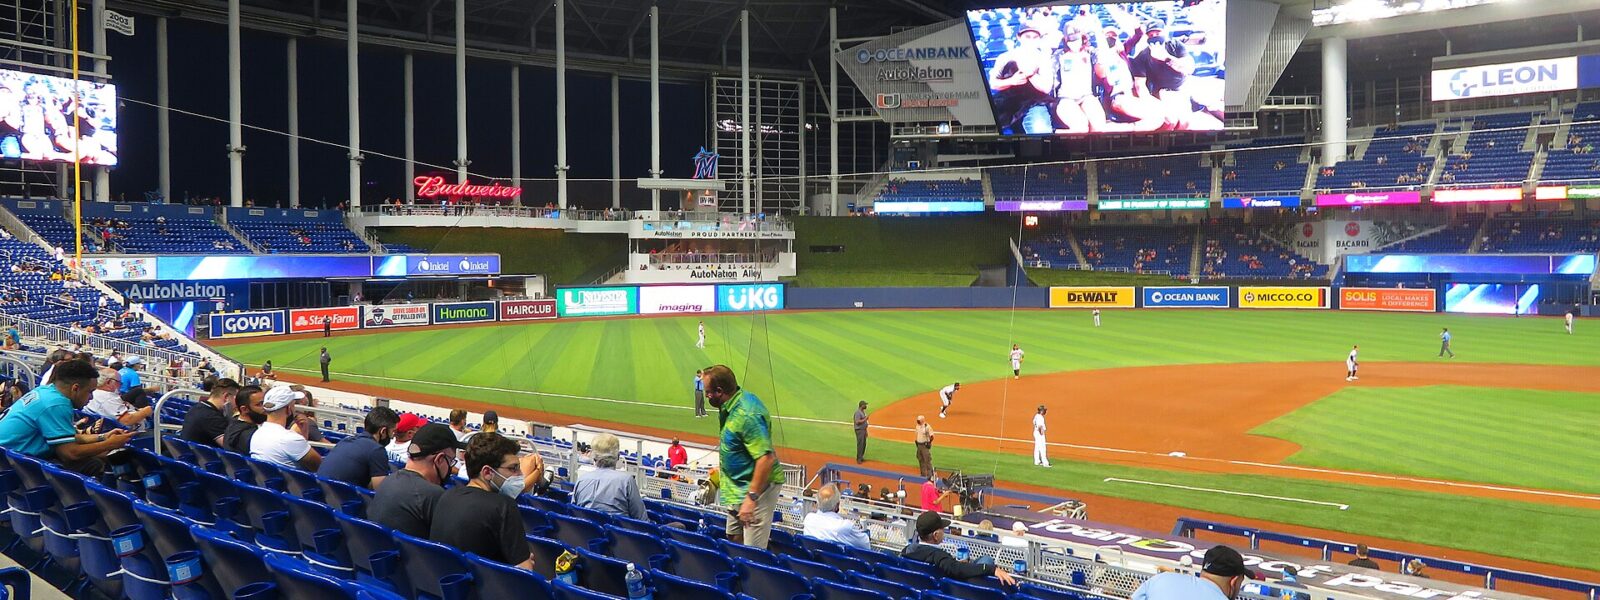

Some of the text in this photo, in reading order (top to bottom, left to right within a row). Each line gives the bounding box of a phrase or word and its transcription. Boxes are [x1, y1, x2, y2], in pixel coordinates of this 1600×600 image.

[110, 13, 128, 25] 2003
[877, 66, 953, 81] AutoNation
[1482, 64, 1557, 87] LEON
[414, 176, 523, 197] Budweiser
[430, 261, 449, 271] Inktel
[470, 261, 489, 270] Inktel
[690, 270, 761, 279] AutoNation Alley
[130, 283, 226, 299] AutoNation
[1345, 291, 1377, 302] SOLIS
[1164, 293, 1220, 301] OCEAN BANK
[1257, 293, 1313, 302] MICCO.CO
[507, 304, 552, 315] HAIRCLUB
[659, 303, 702, 312] imaging
[333, 313, 355, 322] Farm
[225, 315, 271, 332] GOYA
